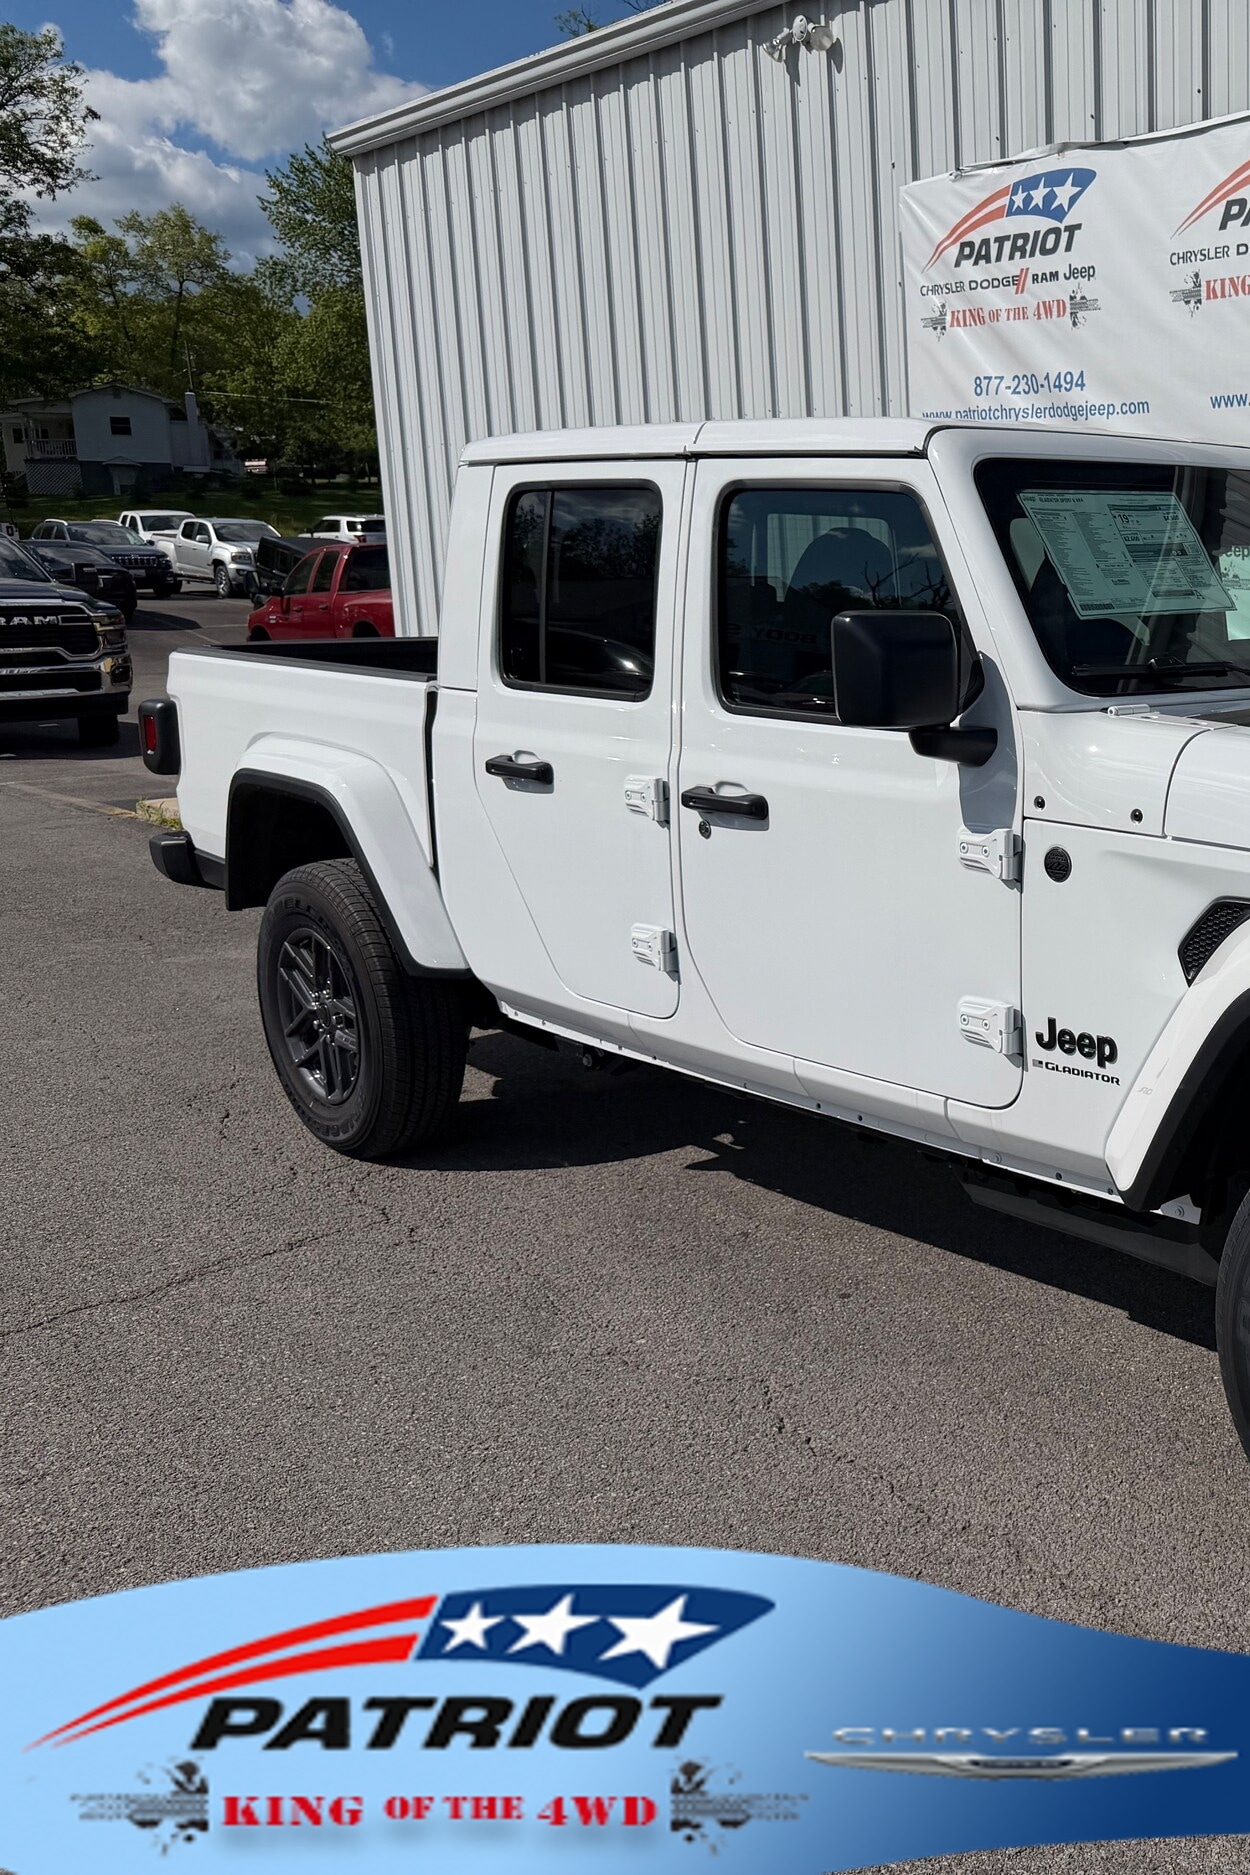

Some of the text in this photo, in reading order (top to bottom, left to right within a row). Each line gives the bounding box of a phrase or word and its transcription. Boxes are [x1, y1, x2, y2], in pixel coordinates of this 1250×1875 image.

[954, 223, 1082, 268] PATRIOT
[1170, 246, 1230, 266] CHRYSLER
[920, 264, 1096, 296] CHRYSLER DODGE RAM Jeep
[950, 299, 1067, 328] KING OF THE 4WD
[974, 370, 1086, 396] 877-230-1494
[1035, 1017, 1118, 1069] Jeep
[1045, 1061, 1120, 1086] GLADIATOR
